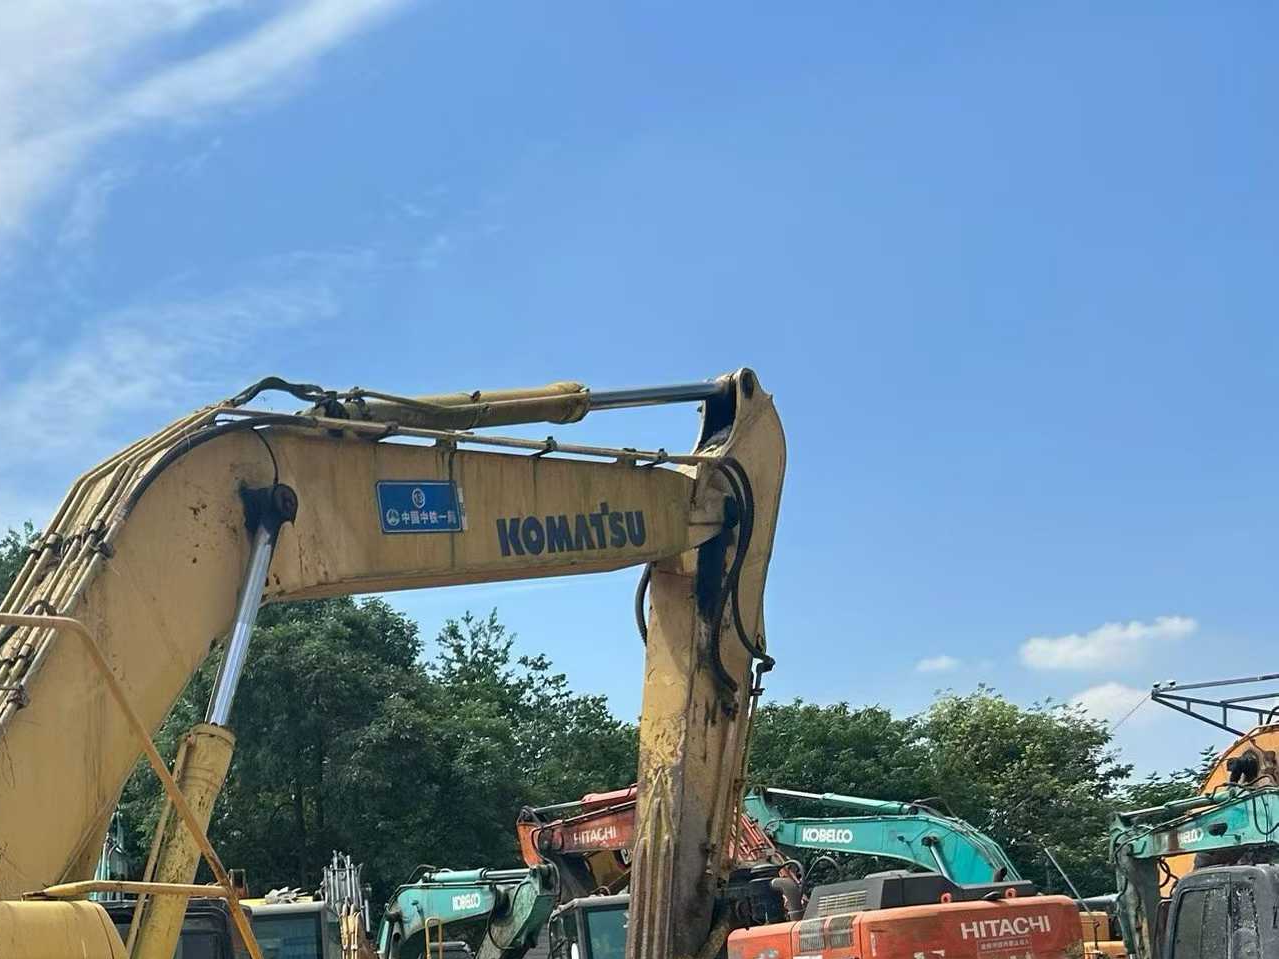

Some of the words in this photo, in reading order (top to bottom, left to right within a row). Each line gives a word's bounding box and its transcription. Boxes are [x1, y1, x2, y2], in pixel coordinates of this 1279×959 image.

[496, 501, 646, 557] KOMATSU
[573, 825, 617, 845] HITACHI
[802, 827, 854, 844] KOBELCO
[960, 915, 1052, 940] HITACHI
